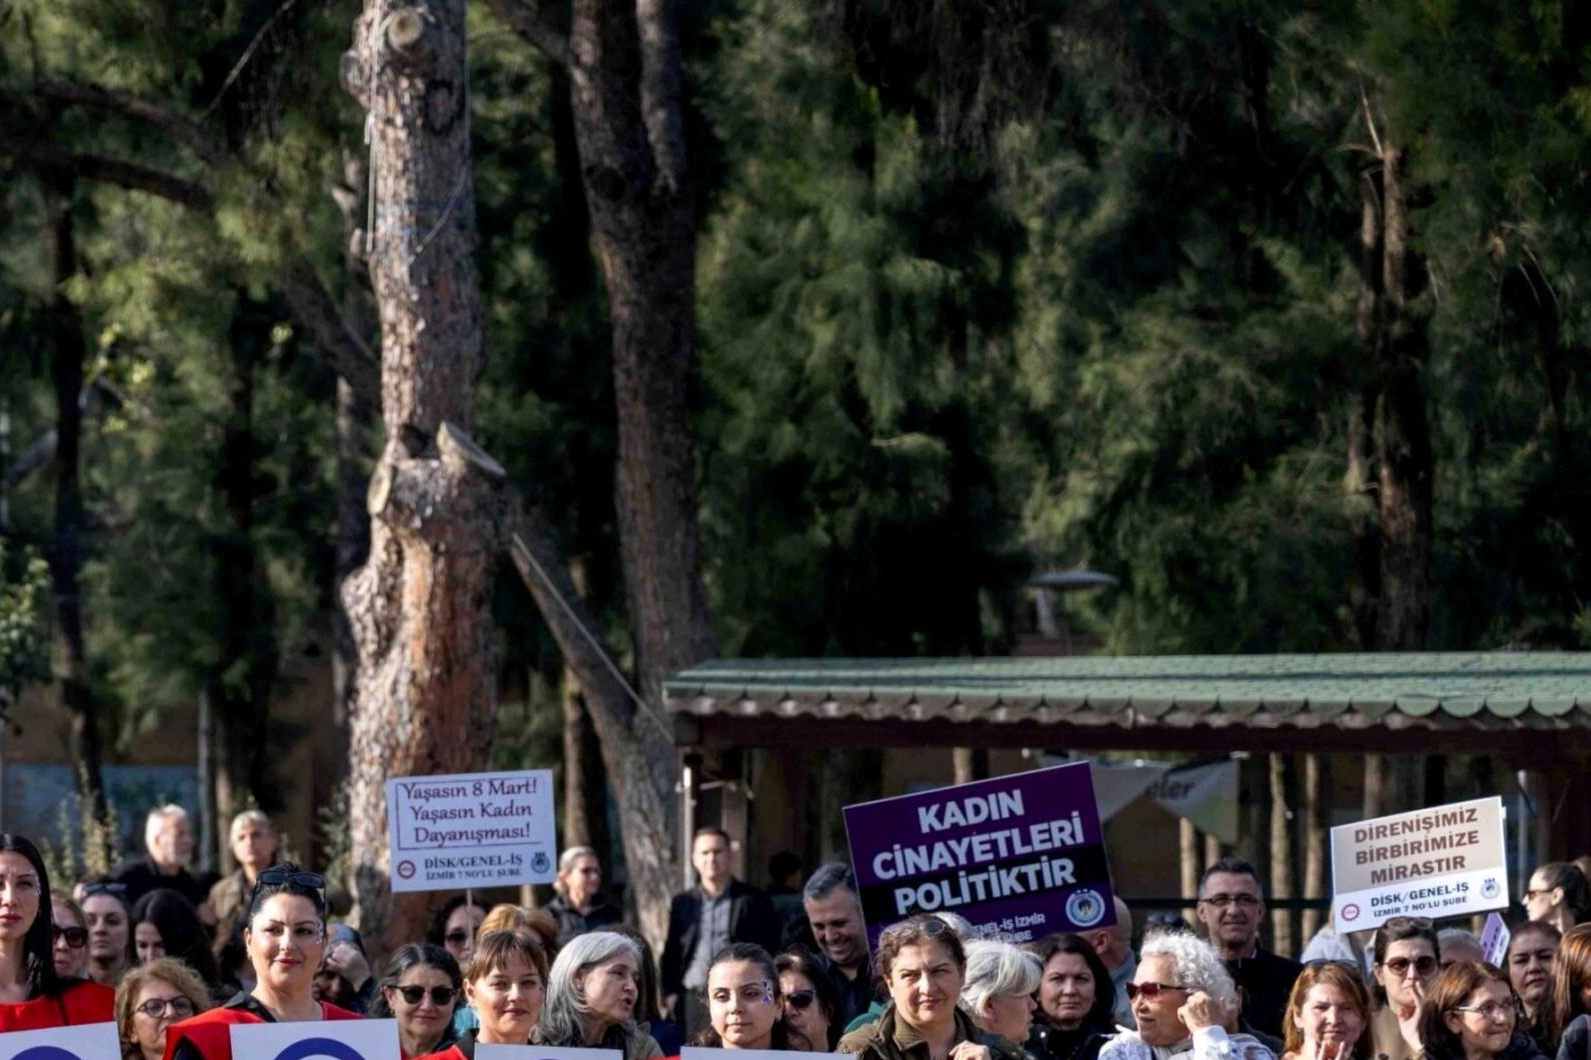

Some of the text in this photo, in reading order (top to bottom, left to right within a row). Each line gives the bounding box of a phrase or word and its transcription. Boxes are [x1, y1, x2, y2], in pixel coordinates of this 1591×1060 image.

[402, 778, 537, 802] Yaşasın 8 Mart!
[411, 799, 533, 824] Yaşasın Kadın
[917, 788, 1025, 834] KADIN
[1354, 806, 1478, 843] DİRENİŞİMİZ
[414, 822, 530, 848] Dayanışması!
[873, 811, 1085, 880] CİNAYETLERİ
[1356, 830, 1480, 866] BİRBİRİMİZE
[894, 855, 1077, 916] POLİTİKTİR
[1370, 855, 1466, 885] MİRASTIR
[1403, 905, 1409, 914] 7
